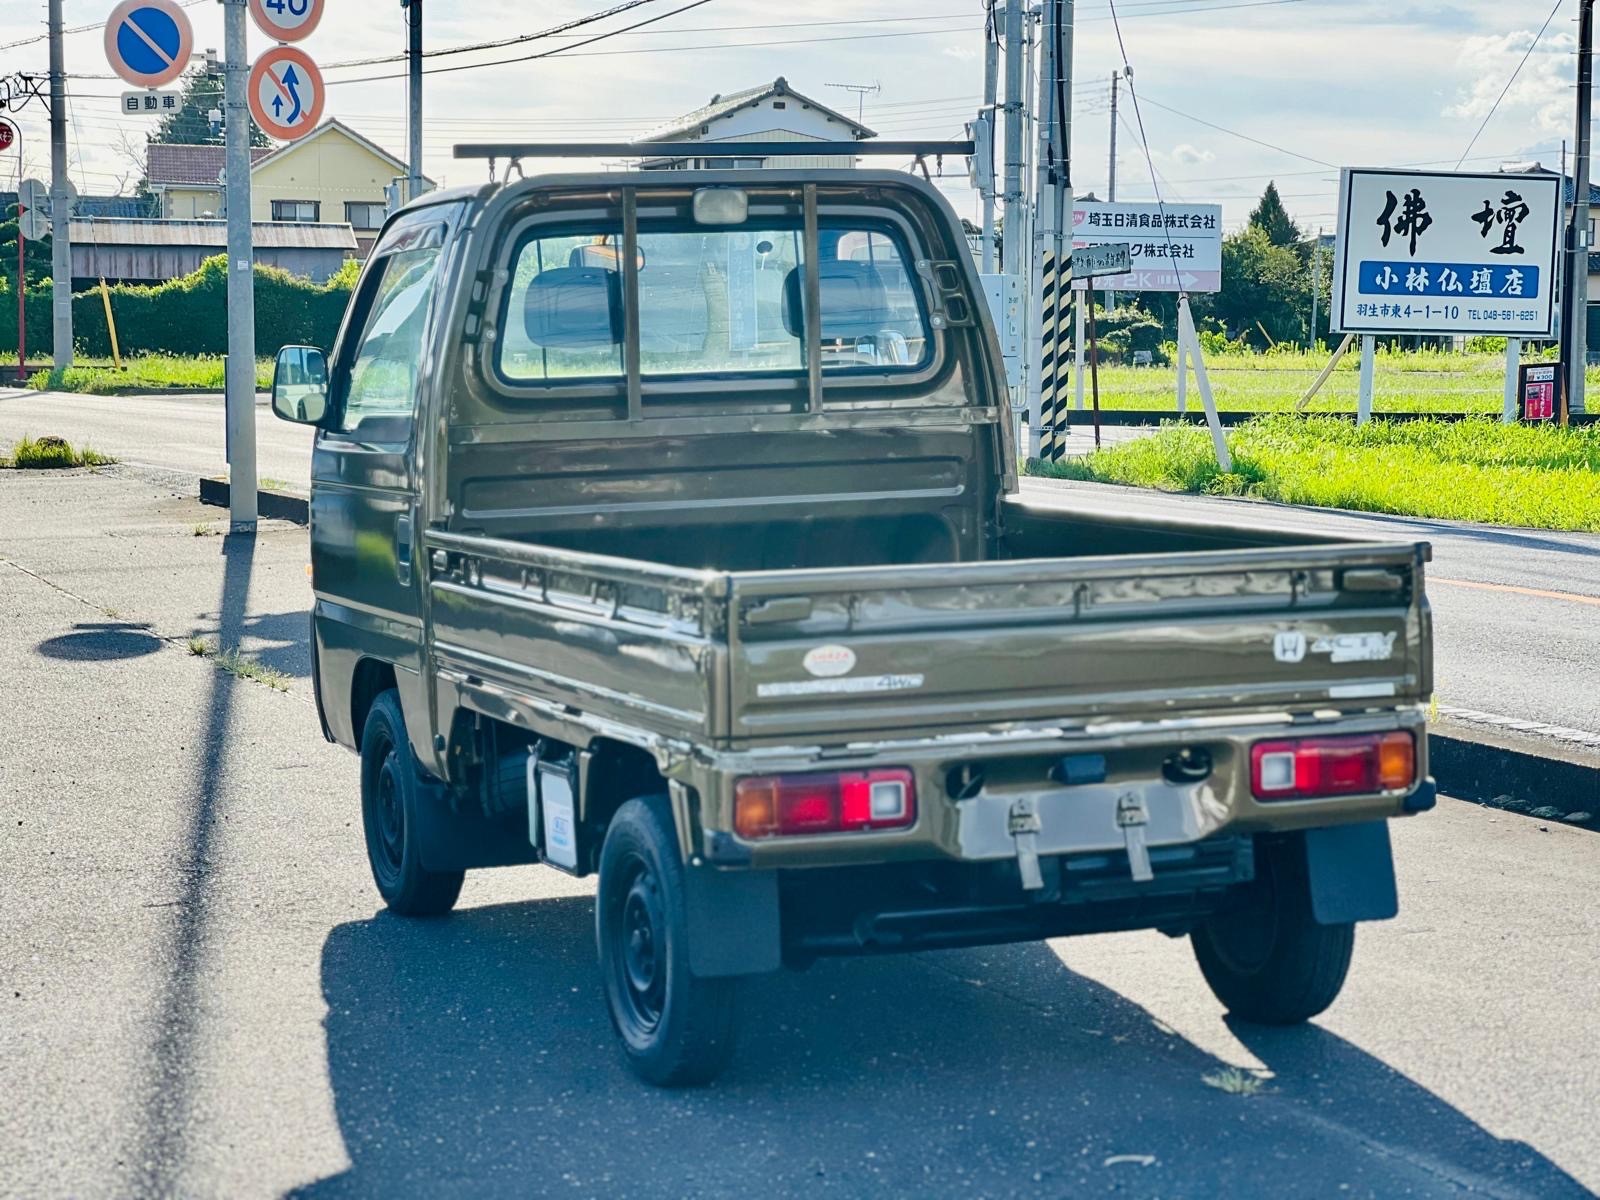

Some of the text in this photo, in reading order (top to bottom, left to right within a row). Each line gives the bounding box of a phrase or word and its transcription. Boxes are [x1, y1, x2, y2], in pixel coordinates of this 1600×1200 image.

[126, 95, 176, 110] 自動車
[1088, 212, 1216, 229] 埼玉日清食品株式会社
[1375, 266, 1525, 296] 小林仏壇店
[1467, 309, 1482, 320] TEL
